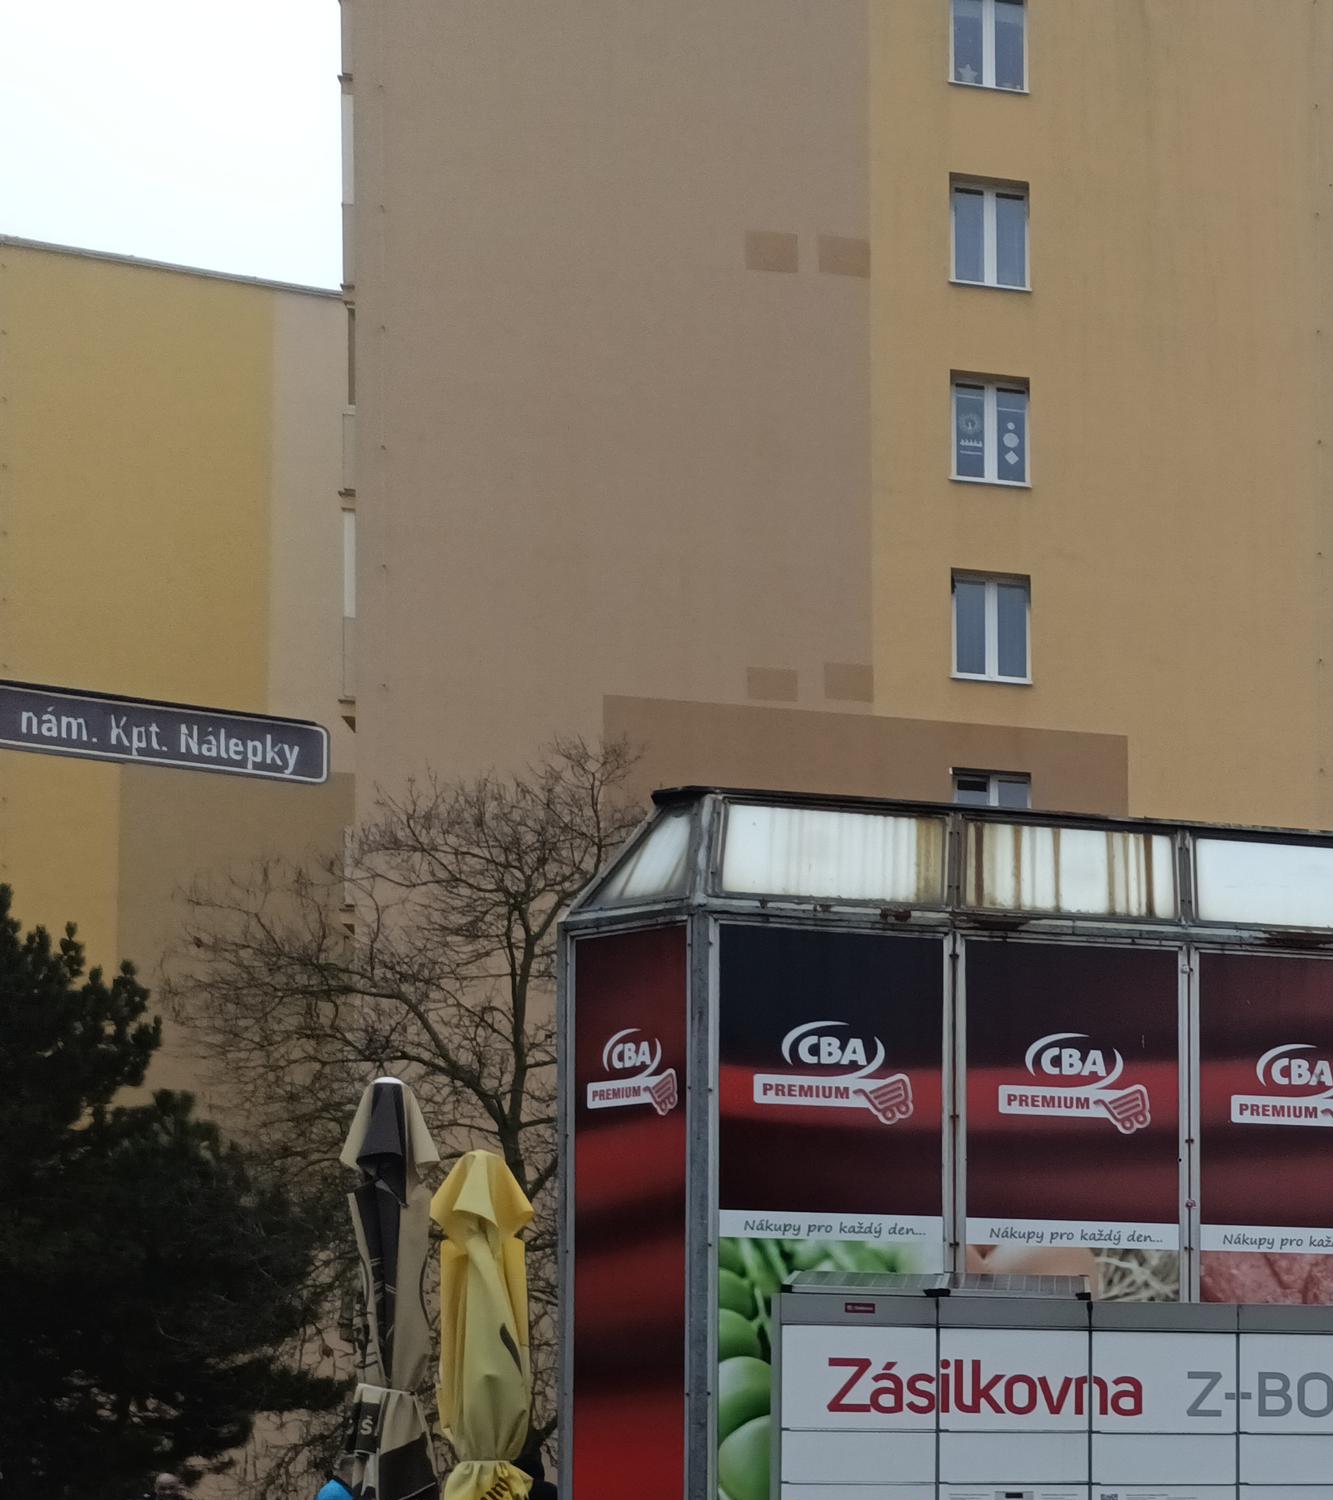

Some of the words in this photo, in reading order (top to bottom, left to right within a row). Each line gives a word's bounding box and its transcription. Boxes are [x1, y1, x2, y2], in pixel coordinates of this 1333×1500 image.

[21, 707, 98, 742] nám.
[111, 714, 168, 756] Kpt.
[180, 723, 299, 773] Nálepky
[612, 1041, 652, 1069] CBA
[798, 1036, 867, 1065] CBA
[1041, 1048, 1106, 1076] CBA
[1271, 1058, 1333, 1086] CBA
[592, 1086, 640, 1101] PREMIUM
[763, 1083, 849, 1099] PREMIUM
[1008, 1094, 1090, 1109] PREMIUM
[1240, 1104, 1318, 1118] PREMIUM
[744, 1218, 801, 1236] Nákupy
[806, 1221, 834, 1237] pro
[839, 1221, 876, 1238] každý
[881, 1222, 926, 1236] den...
[990, 1227, 1044, 1244] Nákupy
[1049, 1230, 1075, 1245] pro
[1080, 1228, 1115, 1245] každý
[1120, 1230, 1163, 1244] den...
[1223, 1233, 1274, 1250] Nákupy
[1280, 1236, 1304, 1251] pro
[827, 1358, 1142, 1416] Zásilkovna
